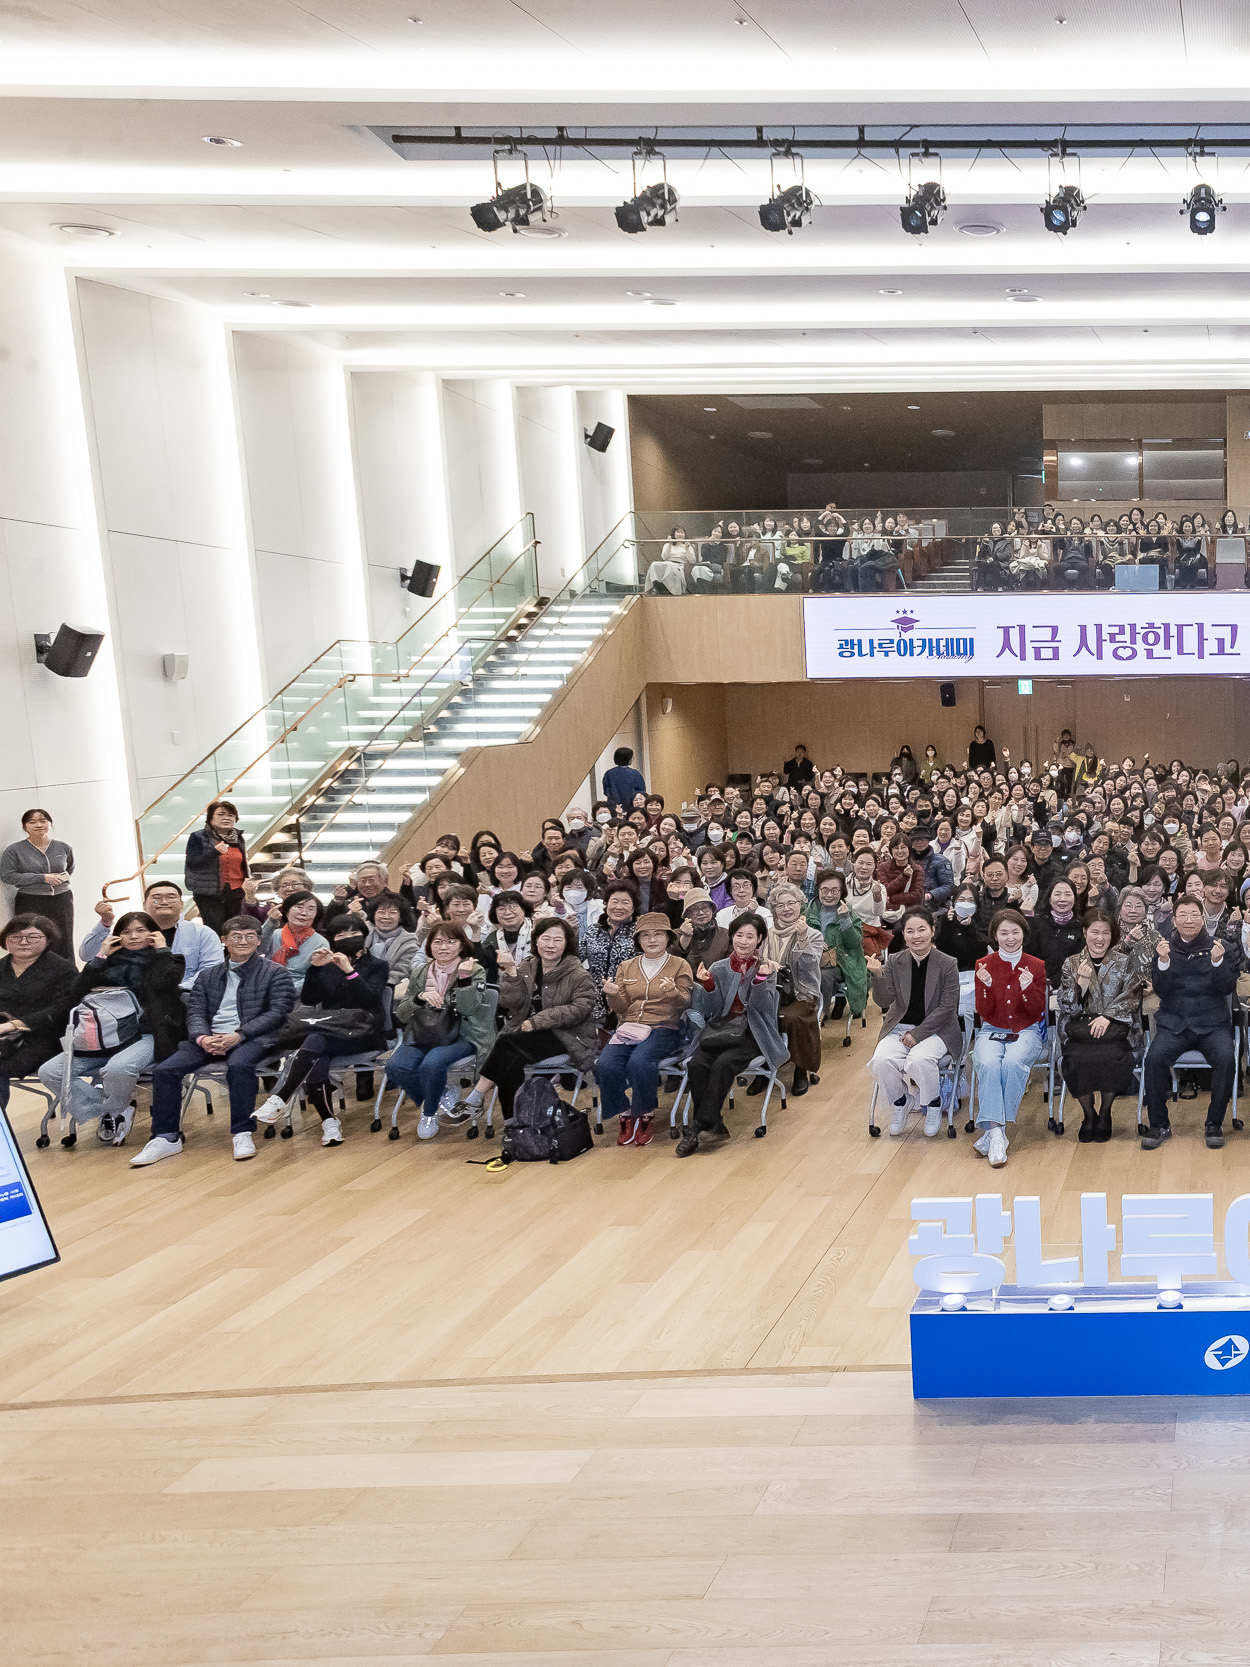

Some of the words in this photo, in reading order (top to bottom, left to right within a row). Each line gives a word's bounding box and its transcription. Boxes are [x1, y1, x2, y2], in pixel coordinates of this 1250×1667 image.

[837, 637, 975, 658] 광나루아카데미
[996, 624, 1062, 661] 지금
[1072, 622, 1241, 661] 사랑한다고
